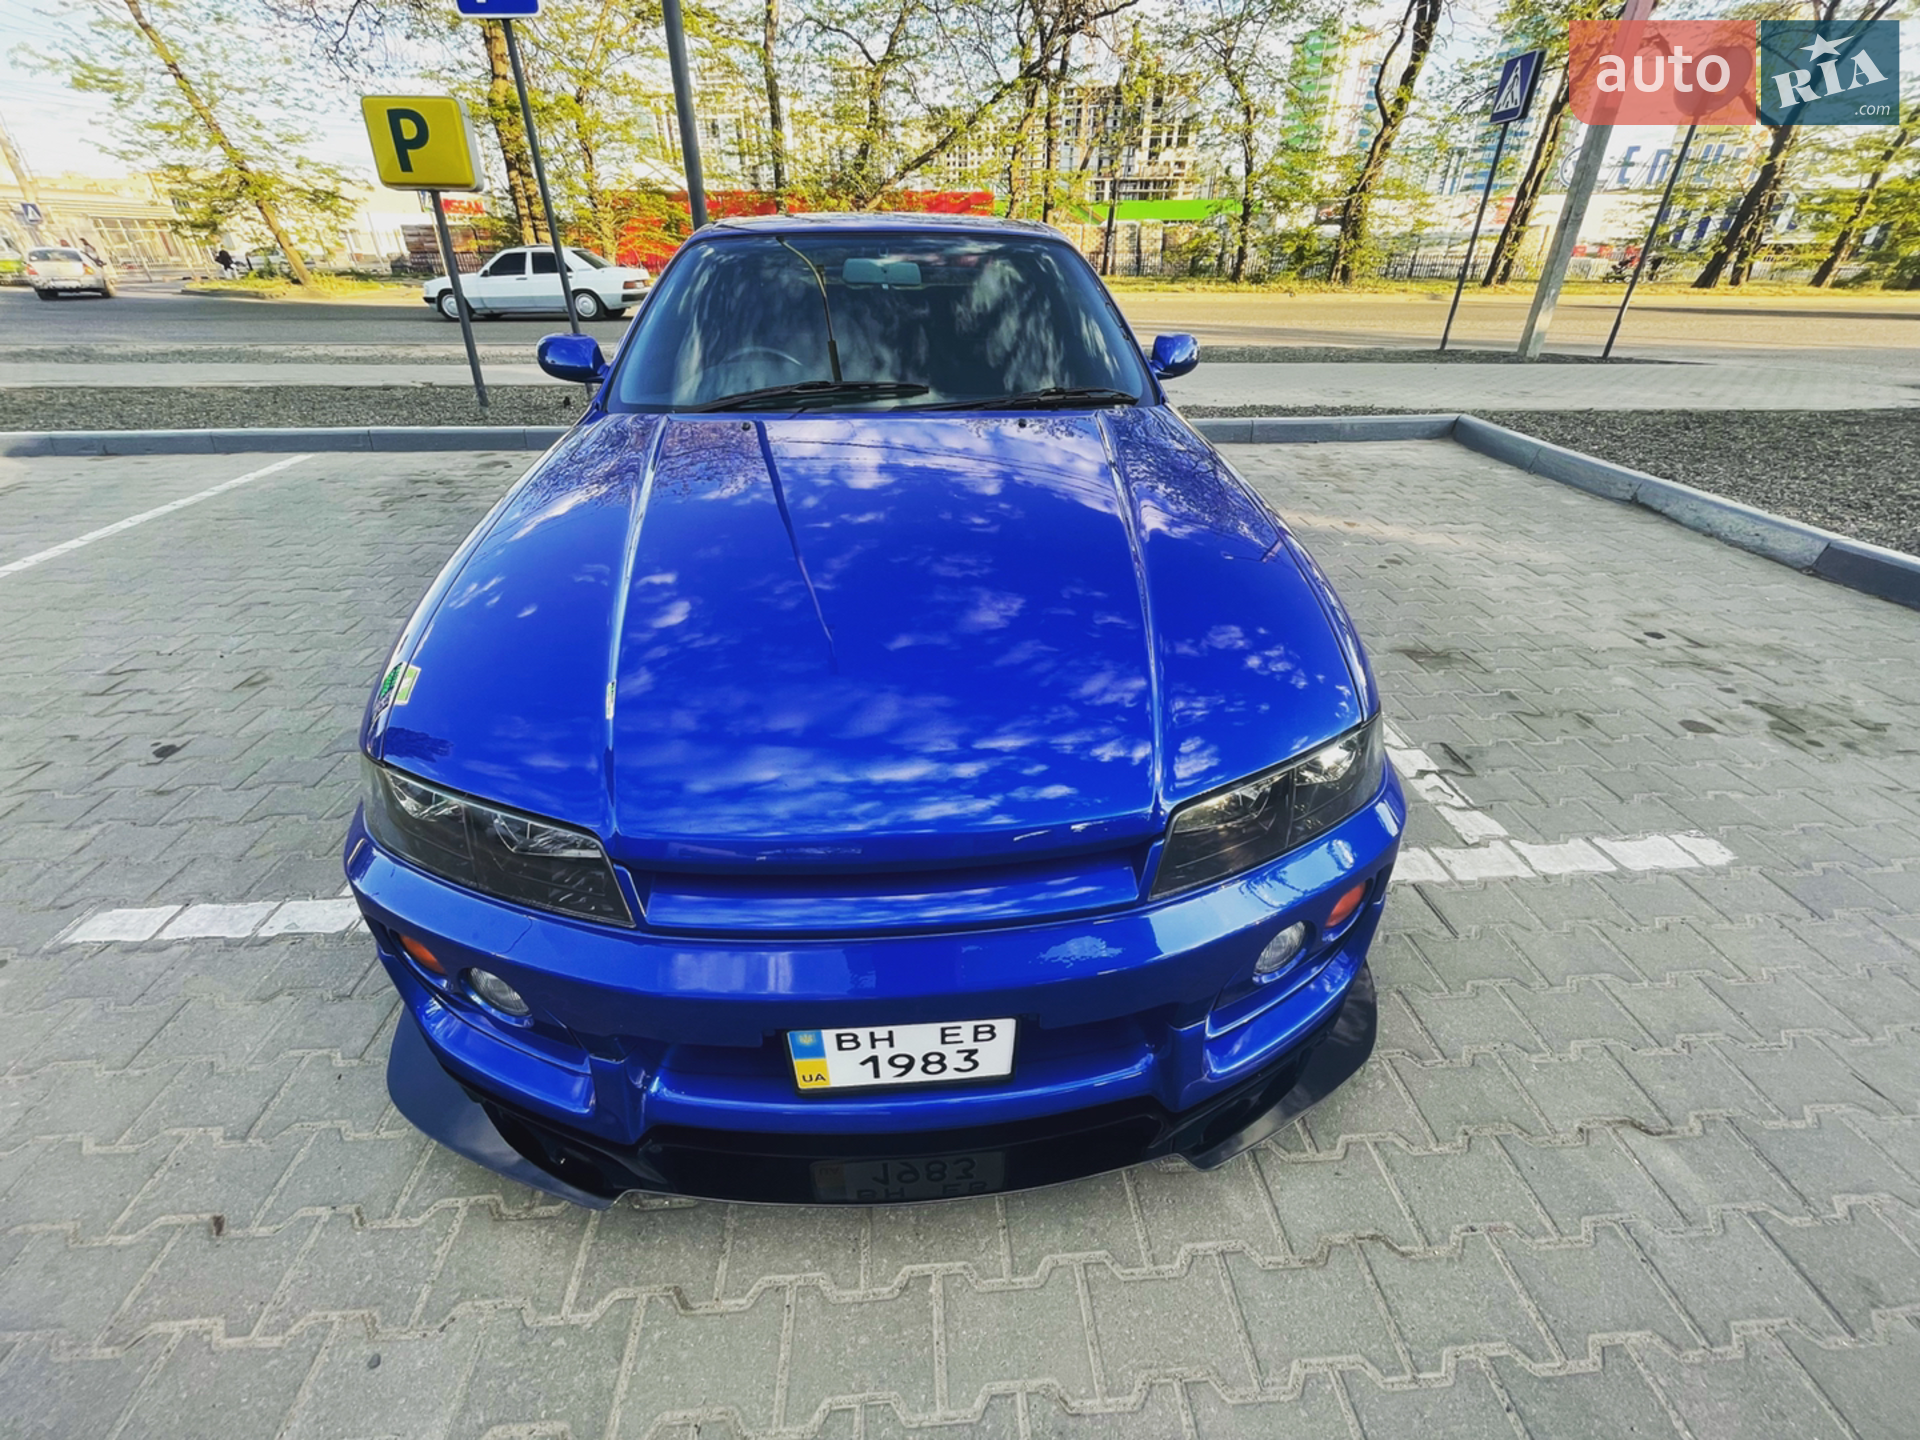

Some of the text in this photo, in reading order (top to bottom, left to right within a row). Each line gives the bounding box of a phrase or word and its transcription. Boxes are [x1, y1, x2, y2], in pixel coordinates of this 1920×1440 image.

[386, 108, 430, 173] P
[835, 1023, 997, 1051] BH EB
[802, 1072, 827, 1083] UA
[859, 1048, 980, 1079] 1983
